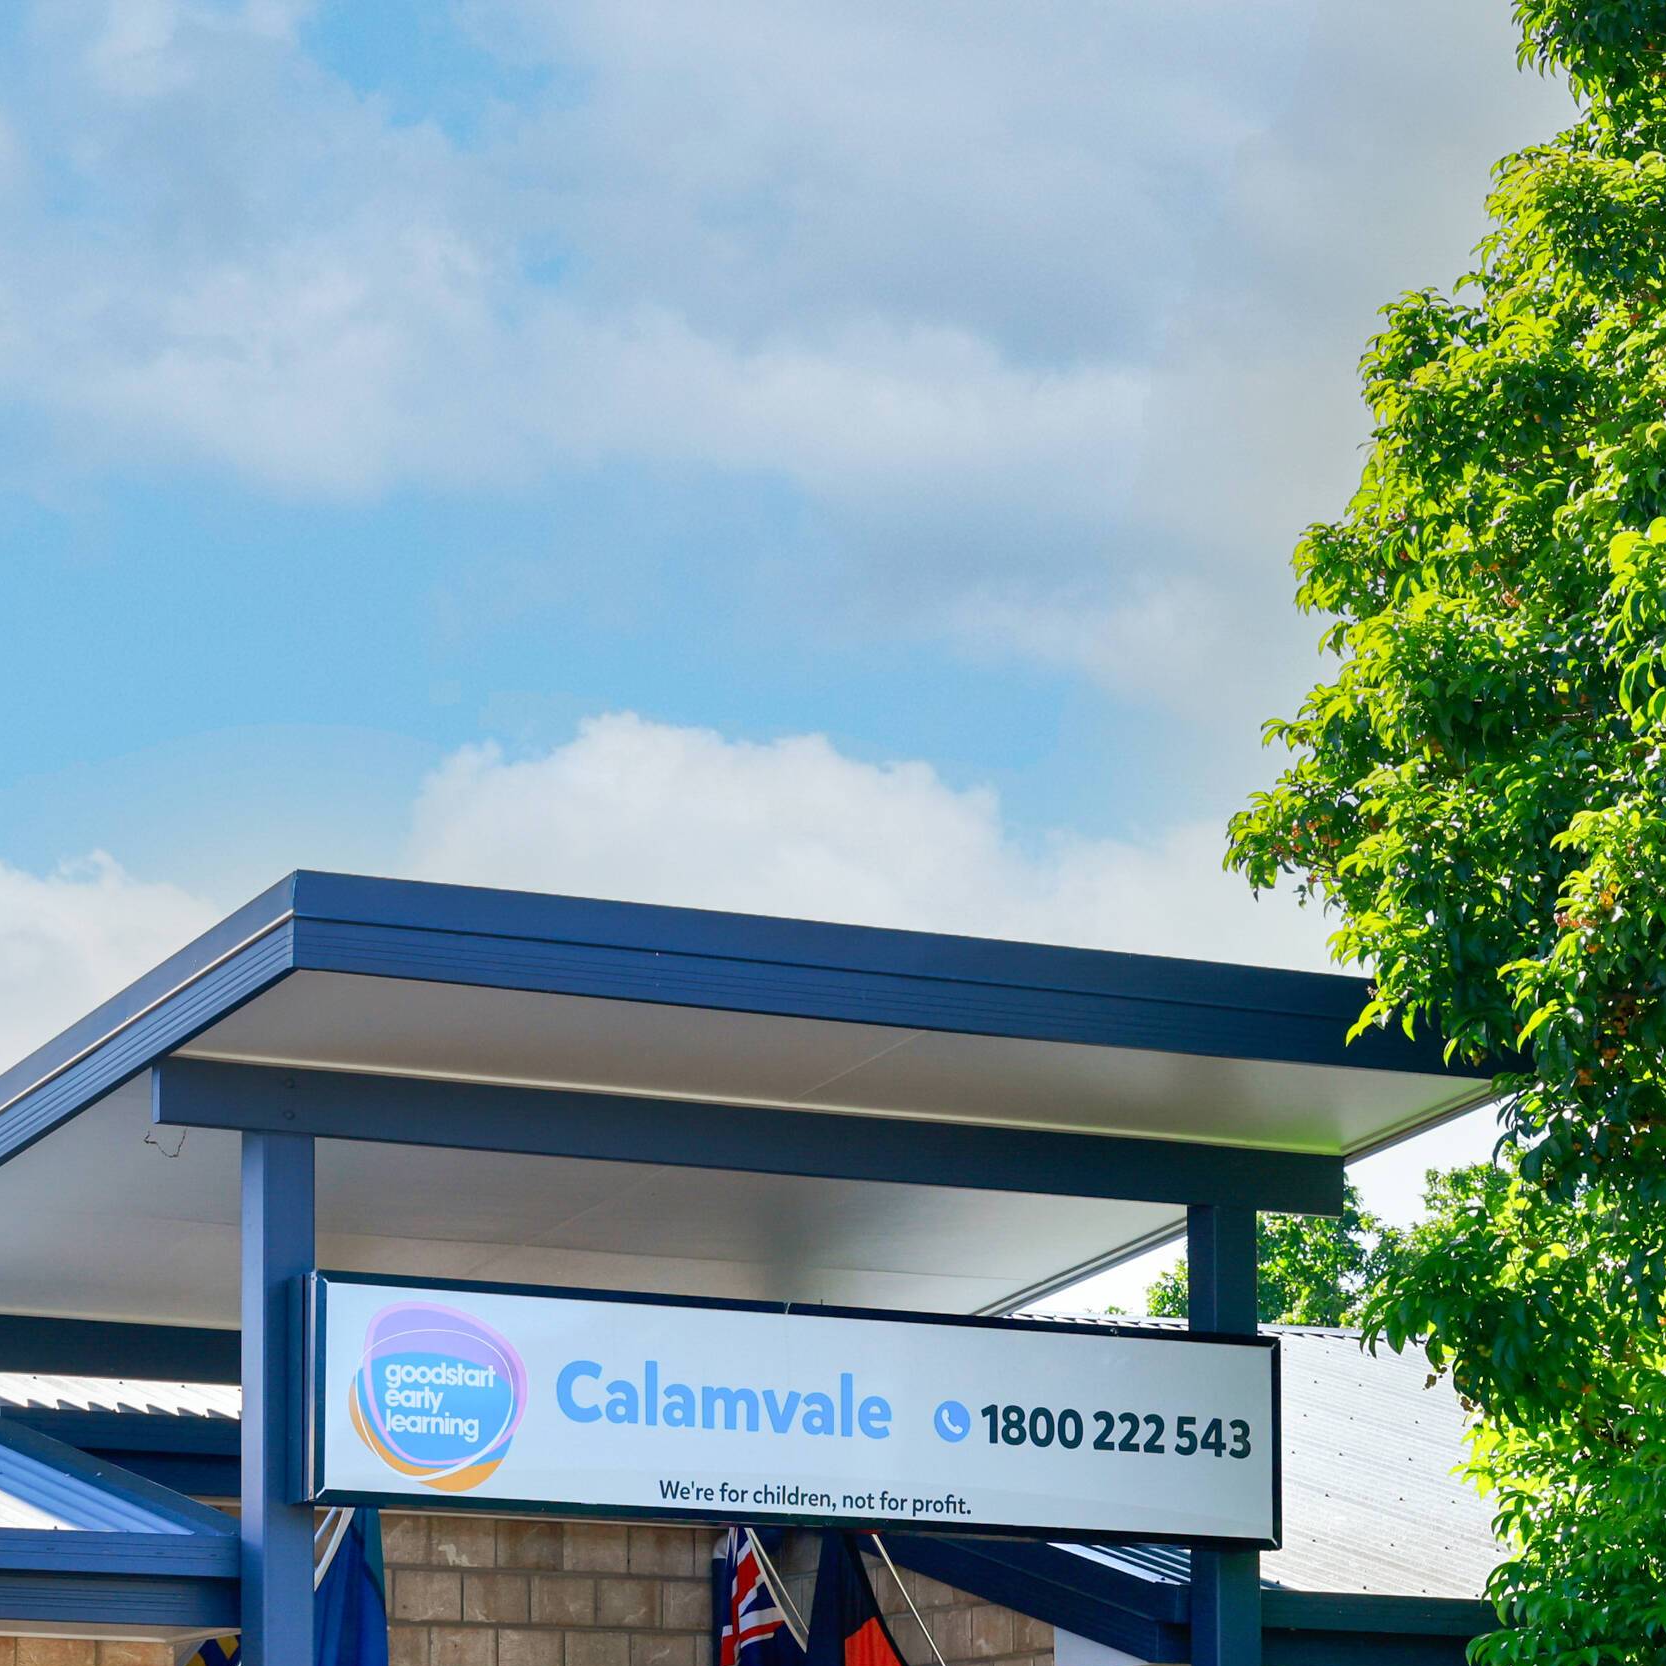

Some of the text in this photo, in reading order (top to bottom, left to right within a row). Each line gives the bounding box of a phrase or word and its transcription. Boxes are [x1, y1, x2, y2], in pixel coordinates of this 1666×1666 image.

[385, 1362, 496, 1388] goodstart
[385, 1387, 443, 1414] early
[556, 1360, 892, 1440] Calamvale
[386, 1409, 480, 1443] learning
[980, 1404, 1252, 1459] 1800 222 543
[659, 1480, 972, 1517] We're for children, not for profit.
